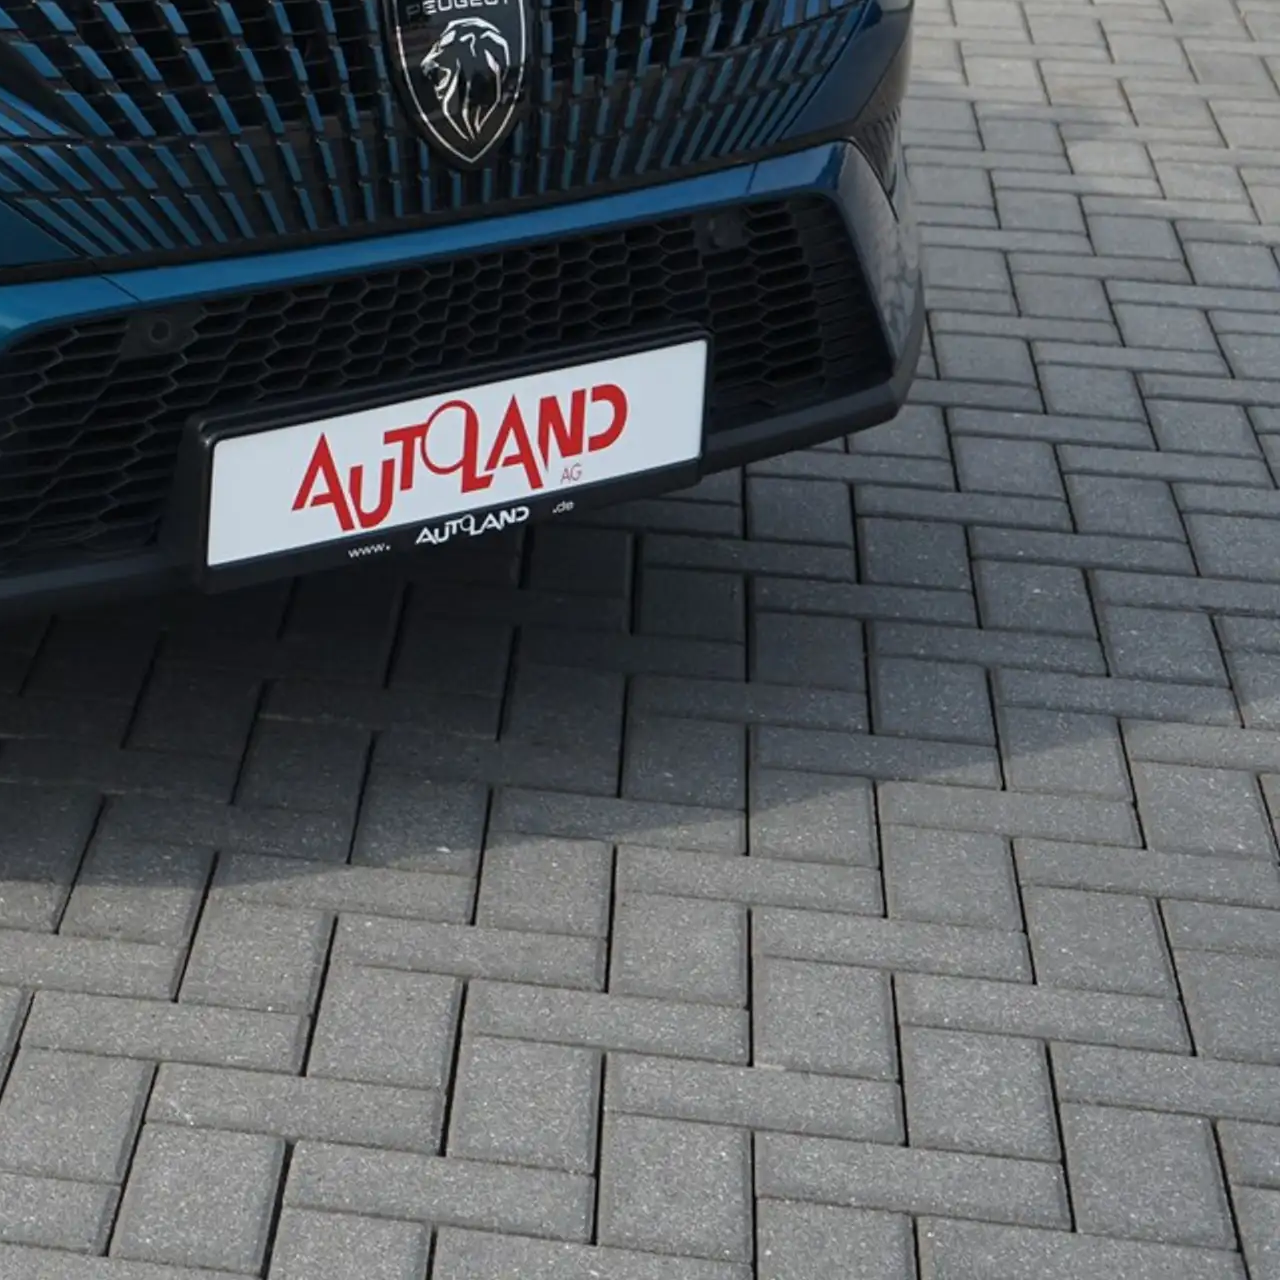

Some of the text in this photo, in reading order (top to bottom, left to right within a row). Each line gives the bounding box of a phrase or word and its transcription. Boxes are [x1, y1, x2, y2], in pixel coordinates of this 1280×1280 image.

[291, 383, 628, 531] AUTOLAND
[559, 462, 582, 484] AG
[347, 500, 576, 558] www. AUTOLAND .de
